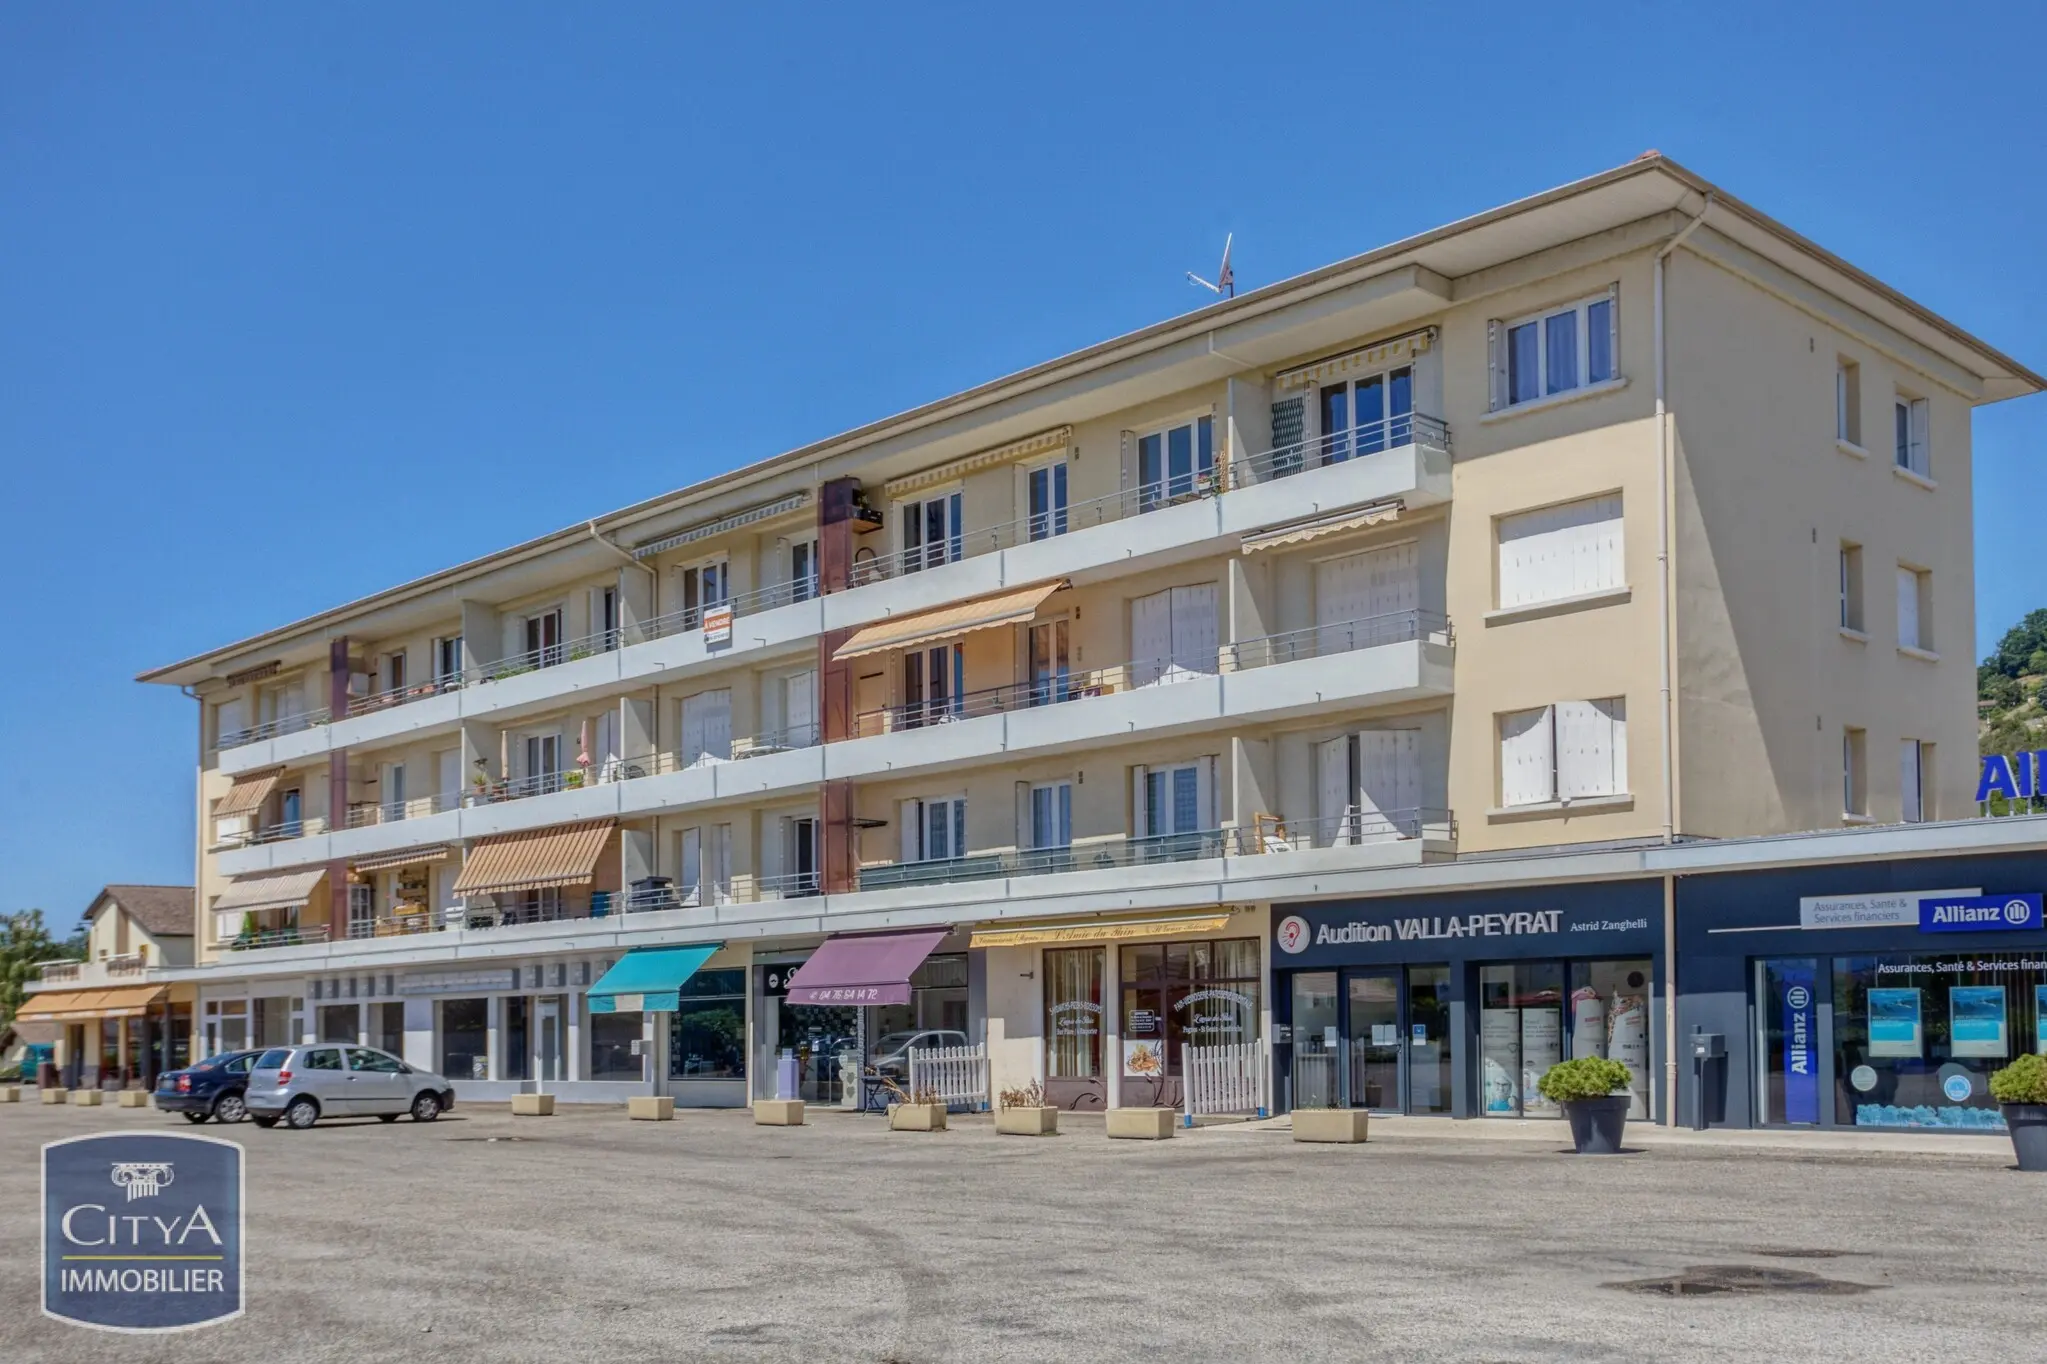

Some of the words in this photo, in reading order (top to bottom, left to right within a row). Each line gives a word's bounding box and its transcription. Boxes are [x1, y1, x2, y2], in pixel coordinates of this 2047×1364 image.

[1813, 902, 1868, 912] Assurances,
[1870, 899, 1897, 909] Santé
[1899, 899, 1907, 908] &
[1814, 913, 1852, 923] Services
[1854, 911, 1900, 921] financiers
[1932, 905, 2000, 923] Allianz
[1316, 922, 1392, 944] Audition
[1394, 910, 1564, 940] VALLA-PEYRAT
[1570, 921, 1599, 932] Astrid
[1601, 918, 1648, 931] Zanghelli
[1878, 963, 1935, 975] Assurances,
[1936, 961, 1964, 972] Santé
[1966, 961, 1975, 971] &
[1977, 960, 2018, 971] Services
[1791, 1012, 1808, 1075] Allianz
